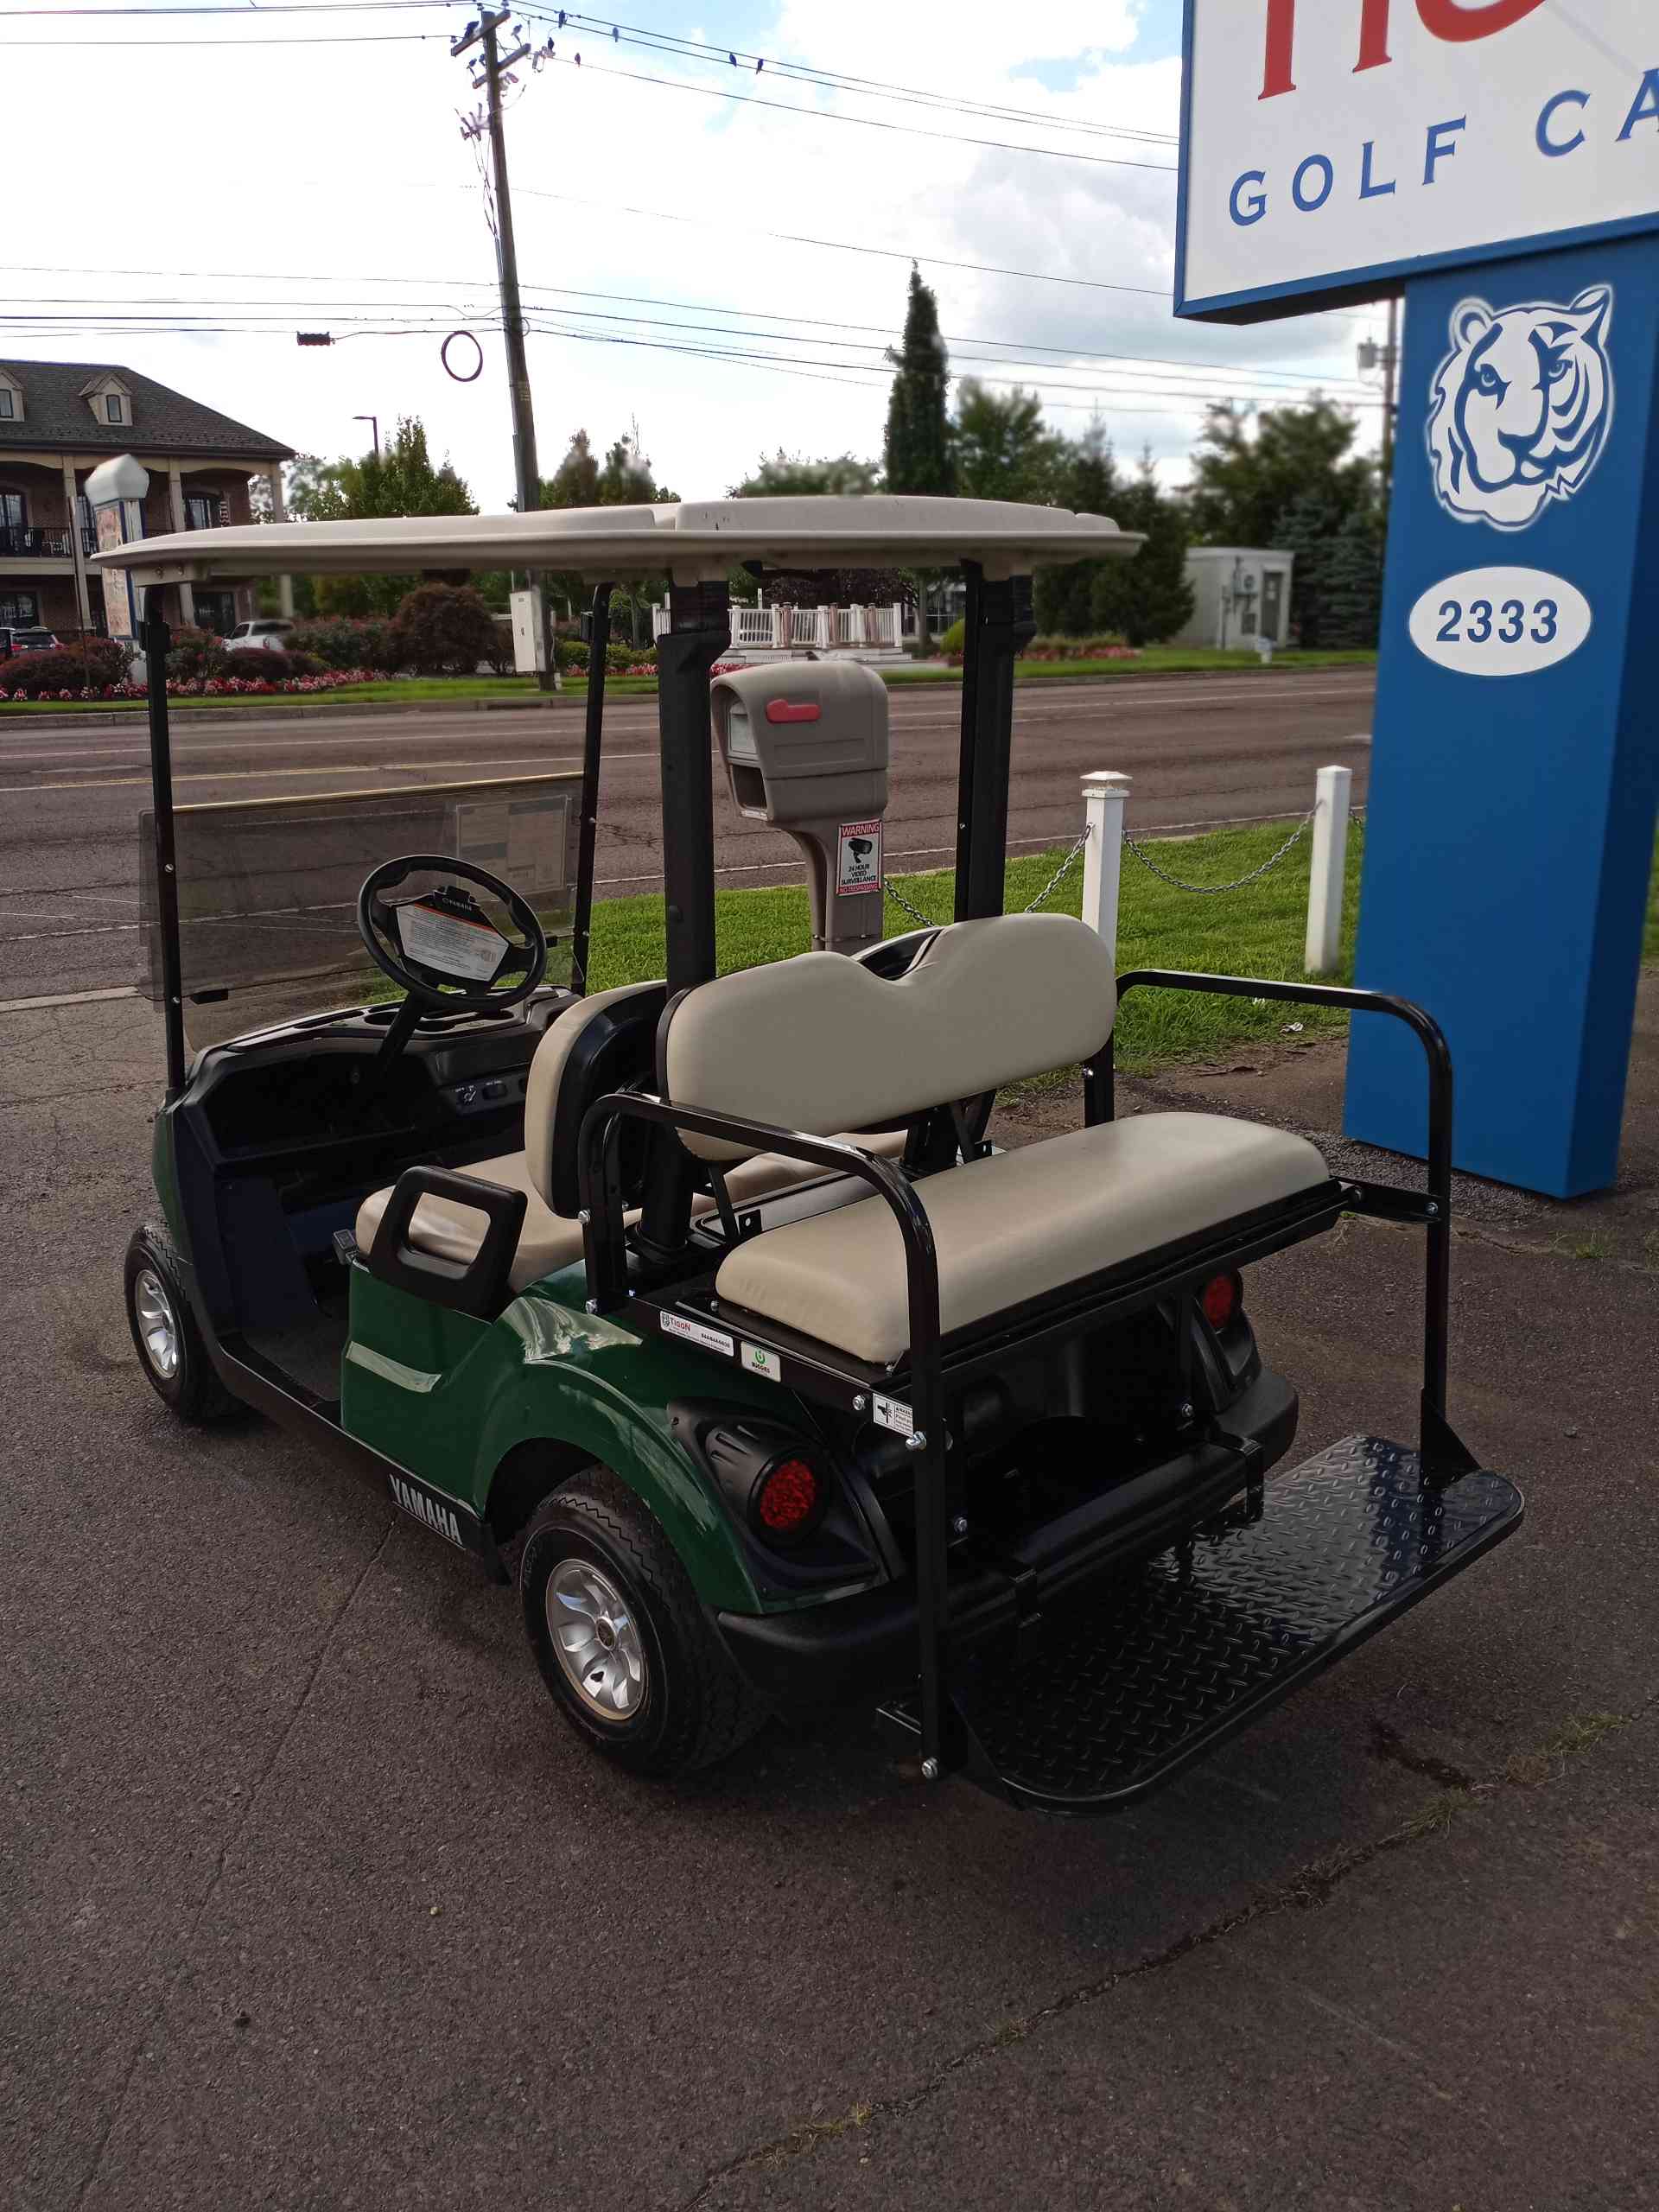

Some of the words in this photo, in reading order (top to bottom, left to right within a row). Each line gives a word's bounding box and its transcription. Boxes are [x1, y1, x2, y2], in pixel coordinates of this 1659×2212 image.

[1229, 114, 1466, 226] GOLF
[1436, 599, 1558, 644] 2333
[842, 823, 879, 836] WARNING
[389, 1473, 463, 1546] YAMAHA
